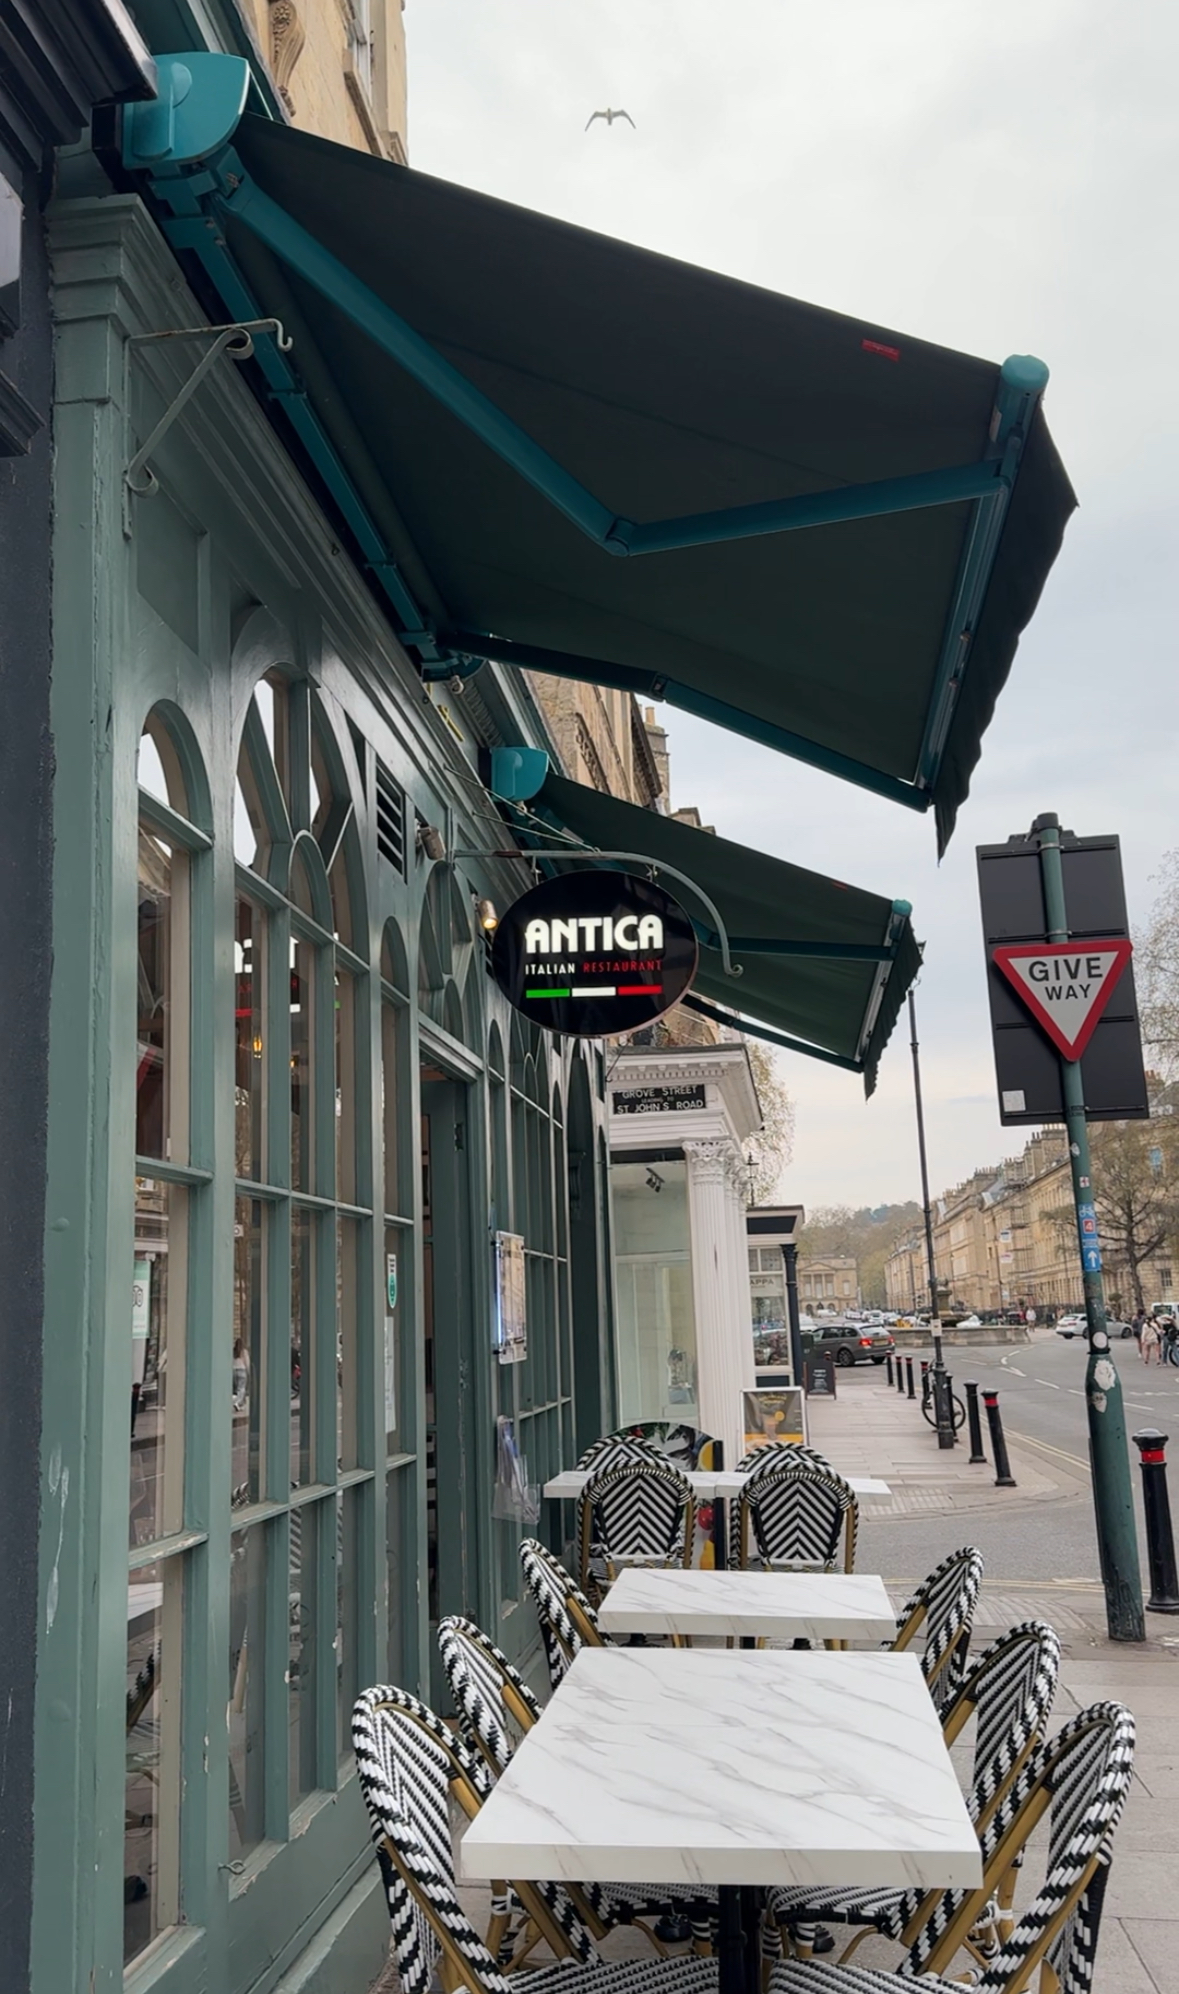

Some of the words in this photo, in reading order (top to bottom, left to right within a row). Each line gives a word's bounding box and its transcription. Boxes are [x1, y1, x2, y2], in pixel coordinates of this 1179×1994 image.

[525, 914, 663, 953] ANTICA
[525, 963, 575, 975] ITALIAN
[583, 960, 662, 973] RESTAURANT
[1028, 957, 1103, 982] GIVE
[1045, 984, 1091, 1001] WAY
[622, 1089, 655, 1099] GROVE
[662, 1085, 697, 1096] STREET
[617, 1105, 629, 1114] ST
[676, 1100, 703, 1109] ROAD
